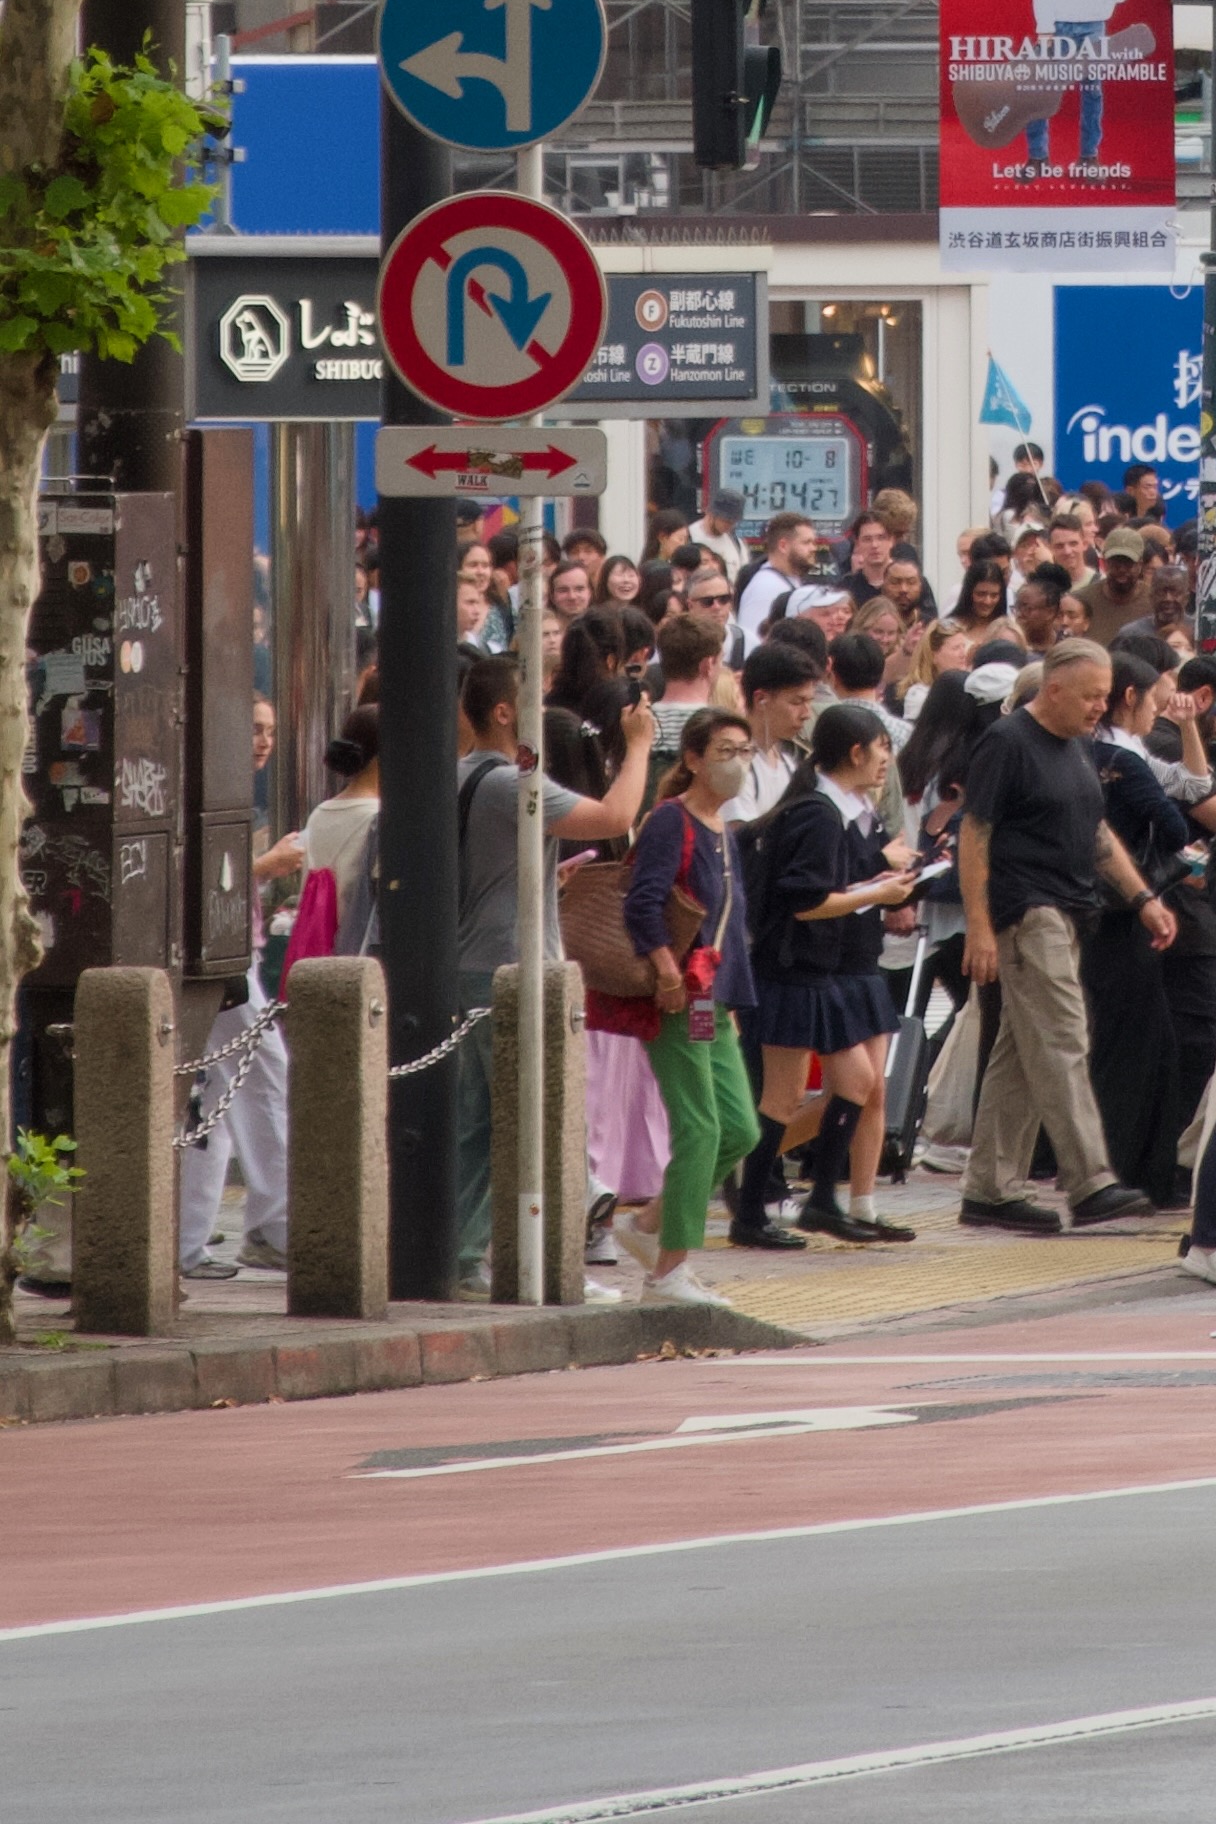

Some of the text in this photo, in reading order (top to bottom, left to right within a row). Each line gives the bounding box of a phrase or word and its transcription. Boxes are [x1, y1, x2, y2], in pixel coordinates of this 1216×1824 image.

[948, 35, 1144, 61] HIRAIDAI with
[948, 63, 1167, 82] SHIBUYA MUSIC SCRAMBLE
[992, 162, 1132, 178] Let's be friends
[948, 230, 1168, 250] 渋谷道玄坂商店街振興組合
[668, 289, 736, 312] 副都心線
[668, 315, 745, 328] Fukutoshin Line
[669, 342, 736, 366] 半蔵門線
[610, 369, 631, 383] Line
[669, 368, 745, 382] Hanzomon Line
[730, 449, 755, 466] WE
[824, 450, 836, 469] 8
[457, 474, 488, 487] WALK
[742, 482, 839, 511] 4:04 27
